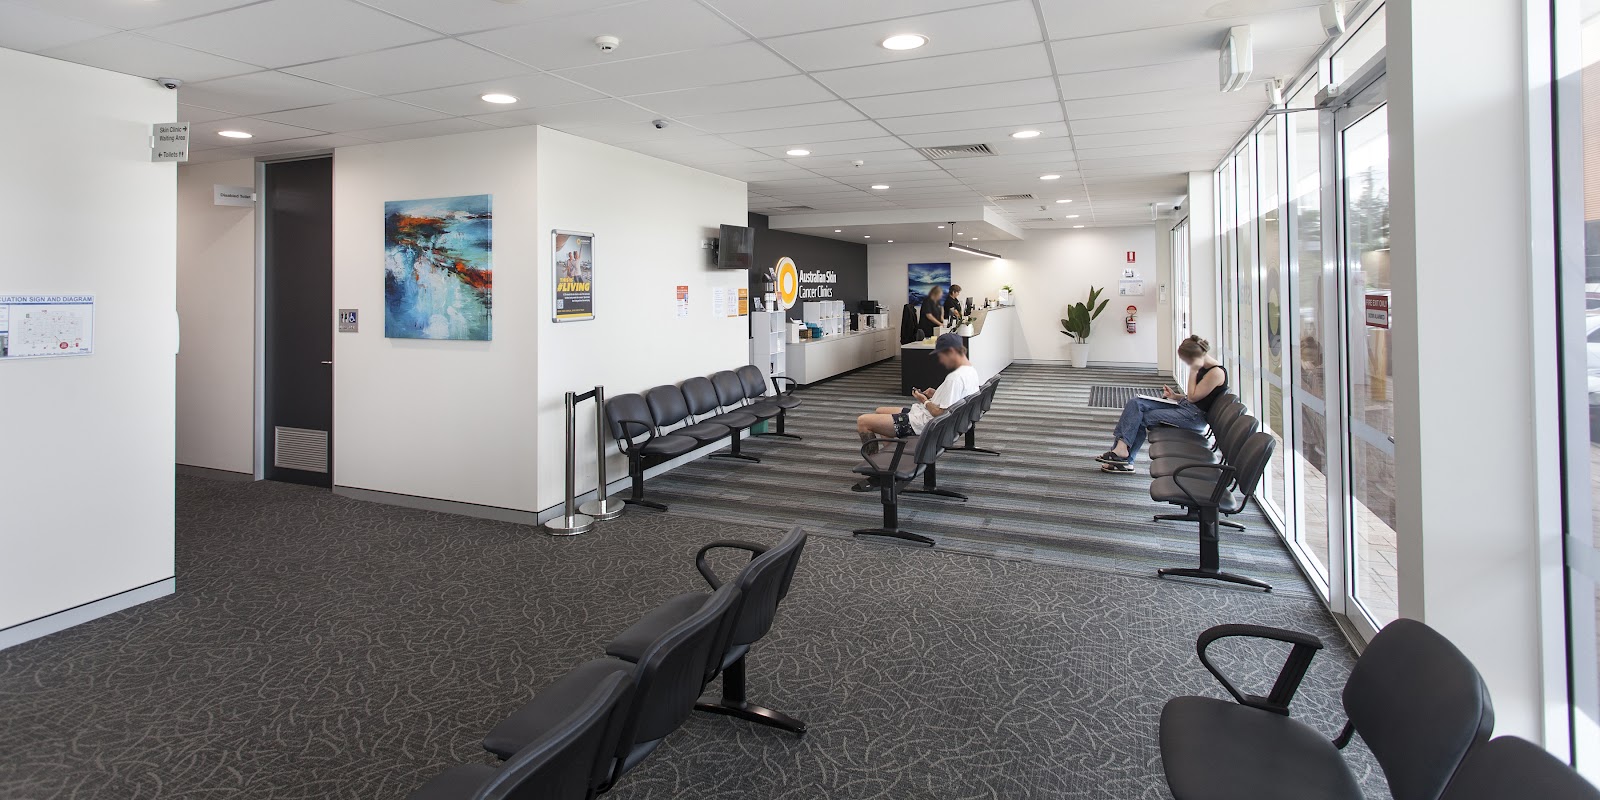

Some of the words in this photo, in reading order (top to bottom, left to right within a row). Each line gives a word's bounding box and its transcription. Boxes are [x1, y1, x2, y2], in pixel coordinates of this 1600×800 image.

[799, 270, 826, 283] Australian
[826, 270, 837, 283] Skin
[557, 282, 590, 292] #LIVING
[799, 285, 818, 298] Cancer
[818, 285, 833, 298] Clinics
